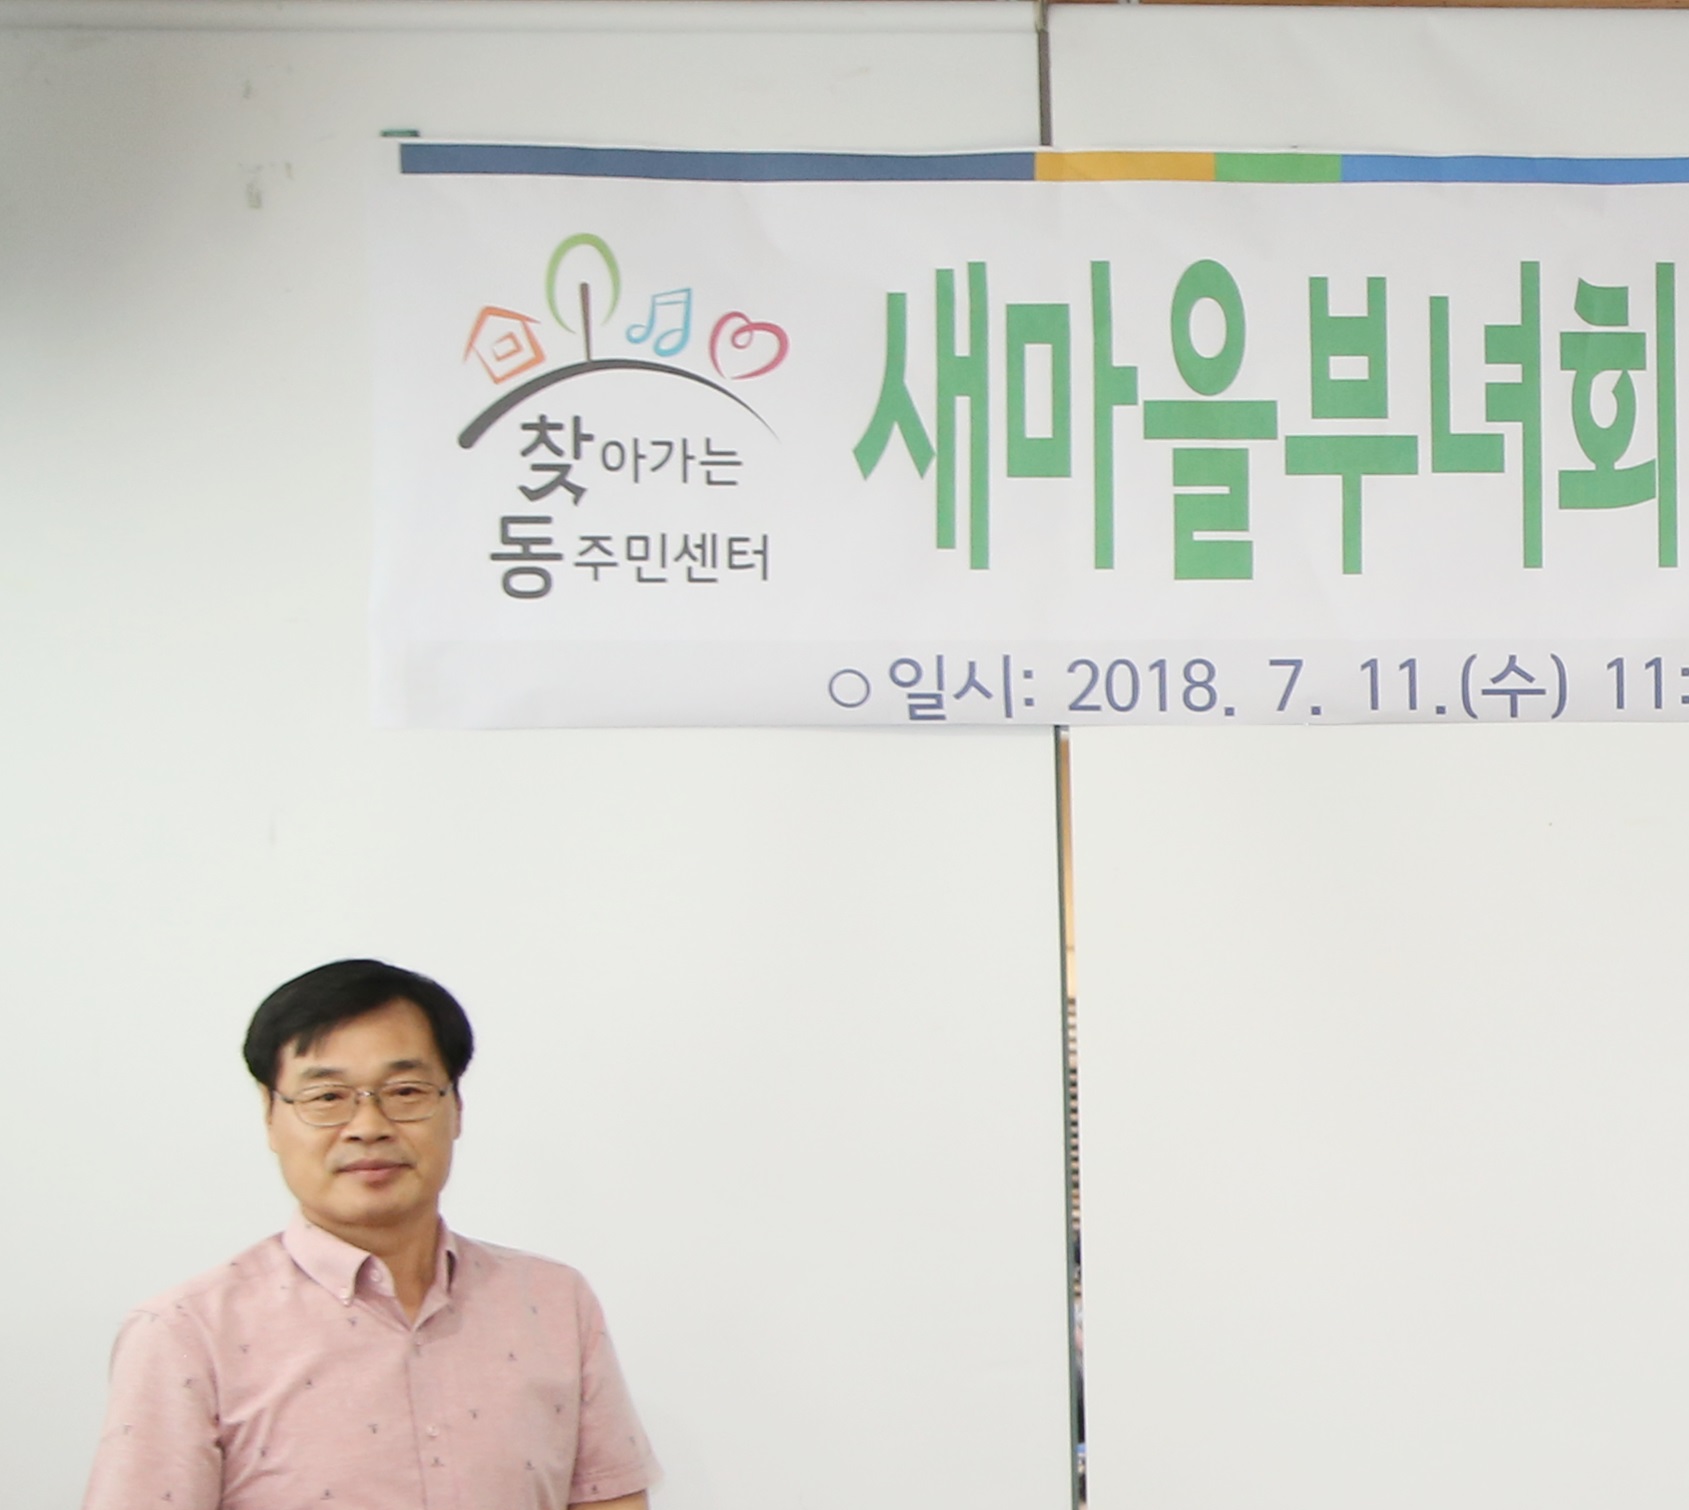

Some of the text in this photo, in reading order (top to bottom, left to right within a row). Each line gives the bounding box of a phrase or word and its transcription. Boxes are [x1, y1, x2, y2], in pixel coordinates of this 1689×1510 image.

[517, 413, 743, 507] 찾아가는
[853, 259, 1678, 580] 새마을부녀회
[489, 515, 768, 600] 동주민센터
[1067, 658, 1235, 717] 2018.
[1269, 659, 1322, 716] 7.
[1360, 653, 1567, 720] 11.(수)
